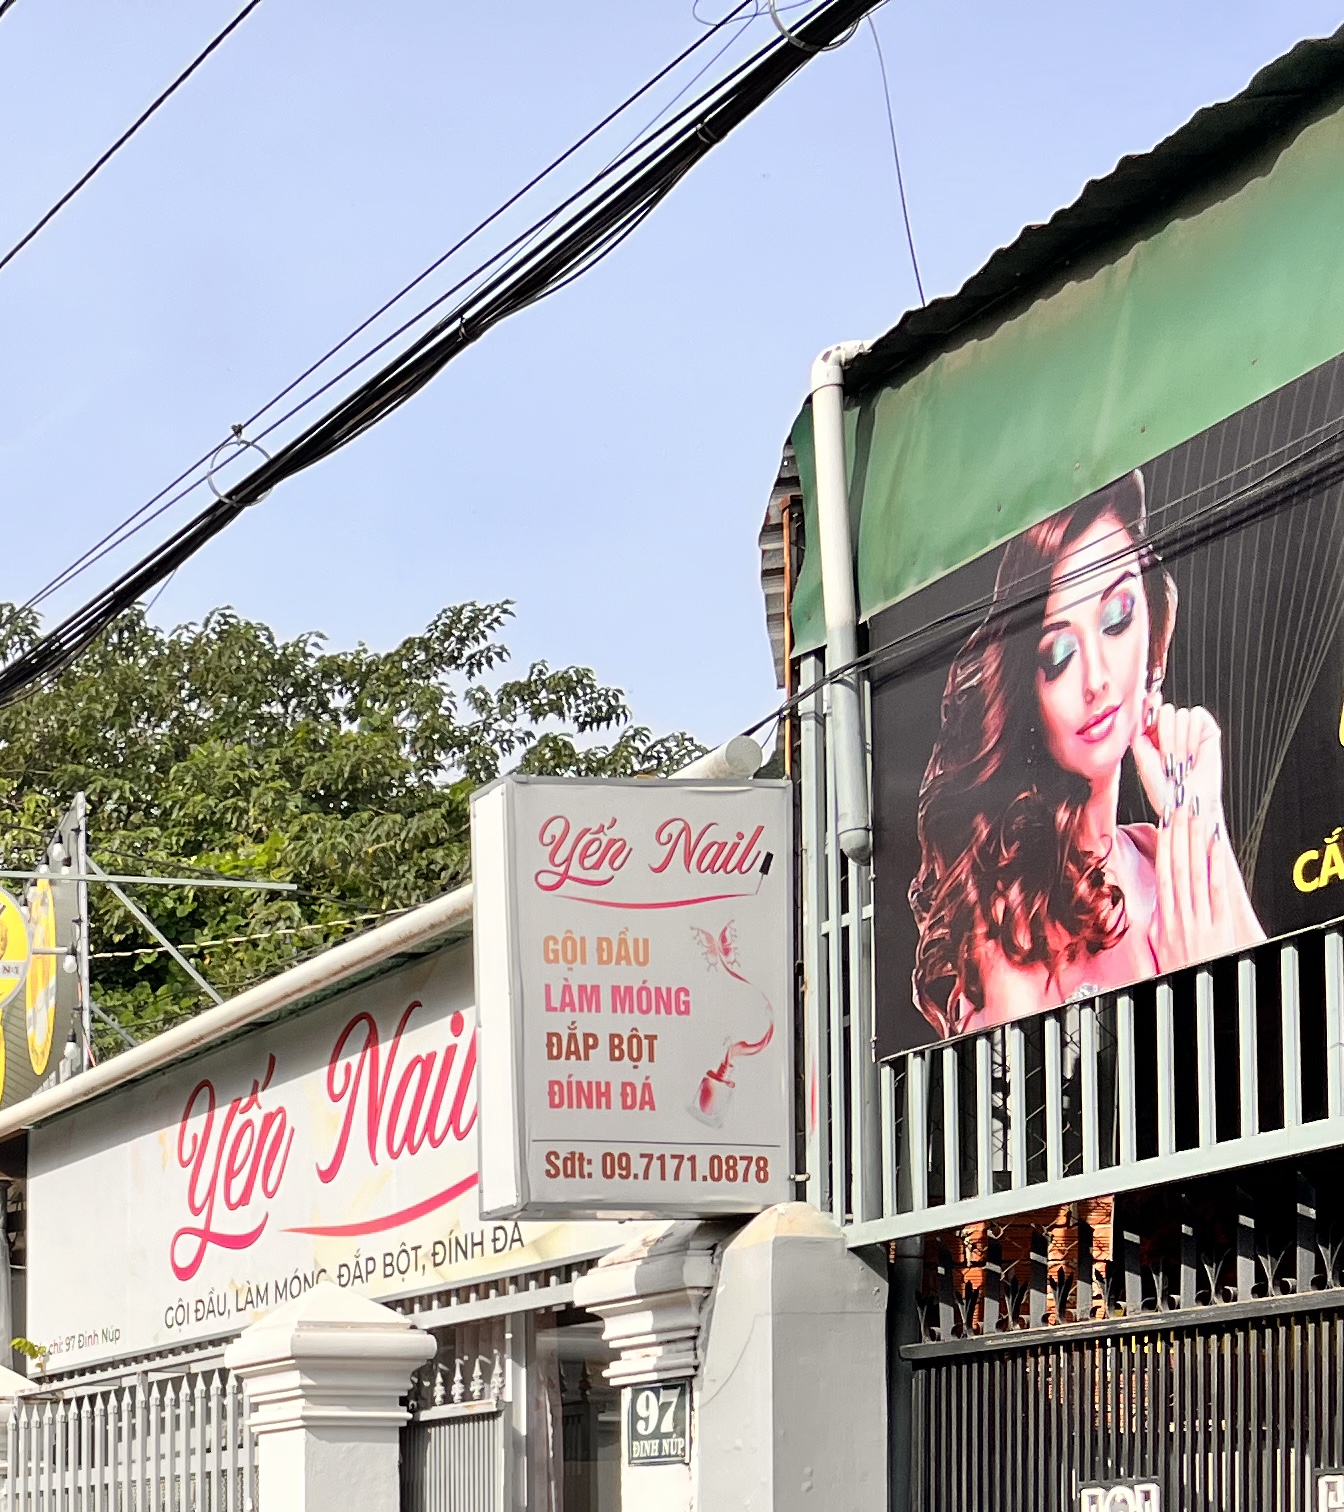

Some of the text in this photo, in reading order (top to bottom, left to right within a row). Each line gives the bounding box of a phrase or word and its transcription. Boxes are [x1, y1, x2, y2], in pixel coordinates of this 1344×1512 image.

[534, 815, 765, 892] Yến Nail
[543, 929, 588, 971] GỘI
[544, 978, 691, 1016] LÀM MÓNG
[546, 1021, 658, 1070] ĐẮP BỘT
[548, 1074, 656, 1111] ĐÍNH ĐÁ
[170, 1053, 295, 1281] Yến
[601, 1152, 769, 1183] 09.7171.0878
[235, 1280, 269, 1312] LÀM
[337, 1247, 376, 1288] ĐẮP
[431, 1224, 485, 1267] ĐÍNH
[65, 1335, 76, 1352] 97
[101, 1324, 121, 1345] Núp
[636, 1386, 681, 1436] 97
